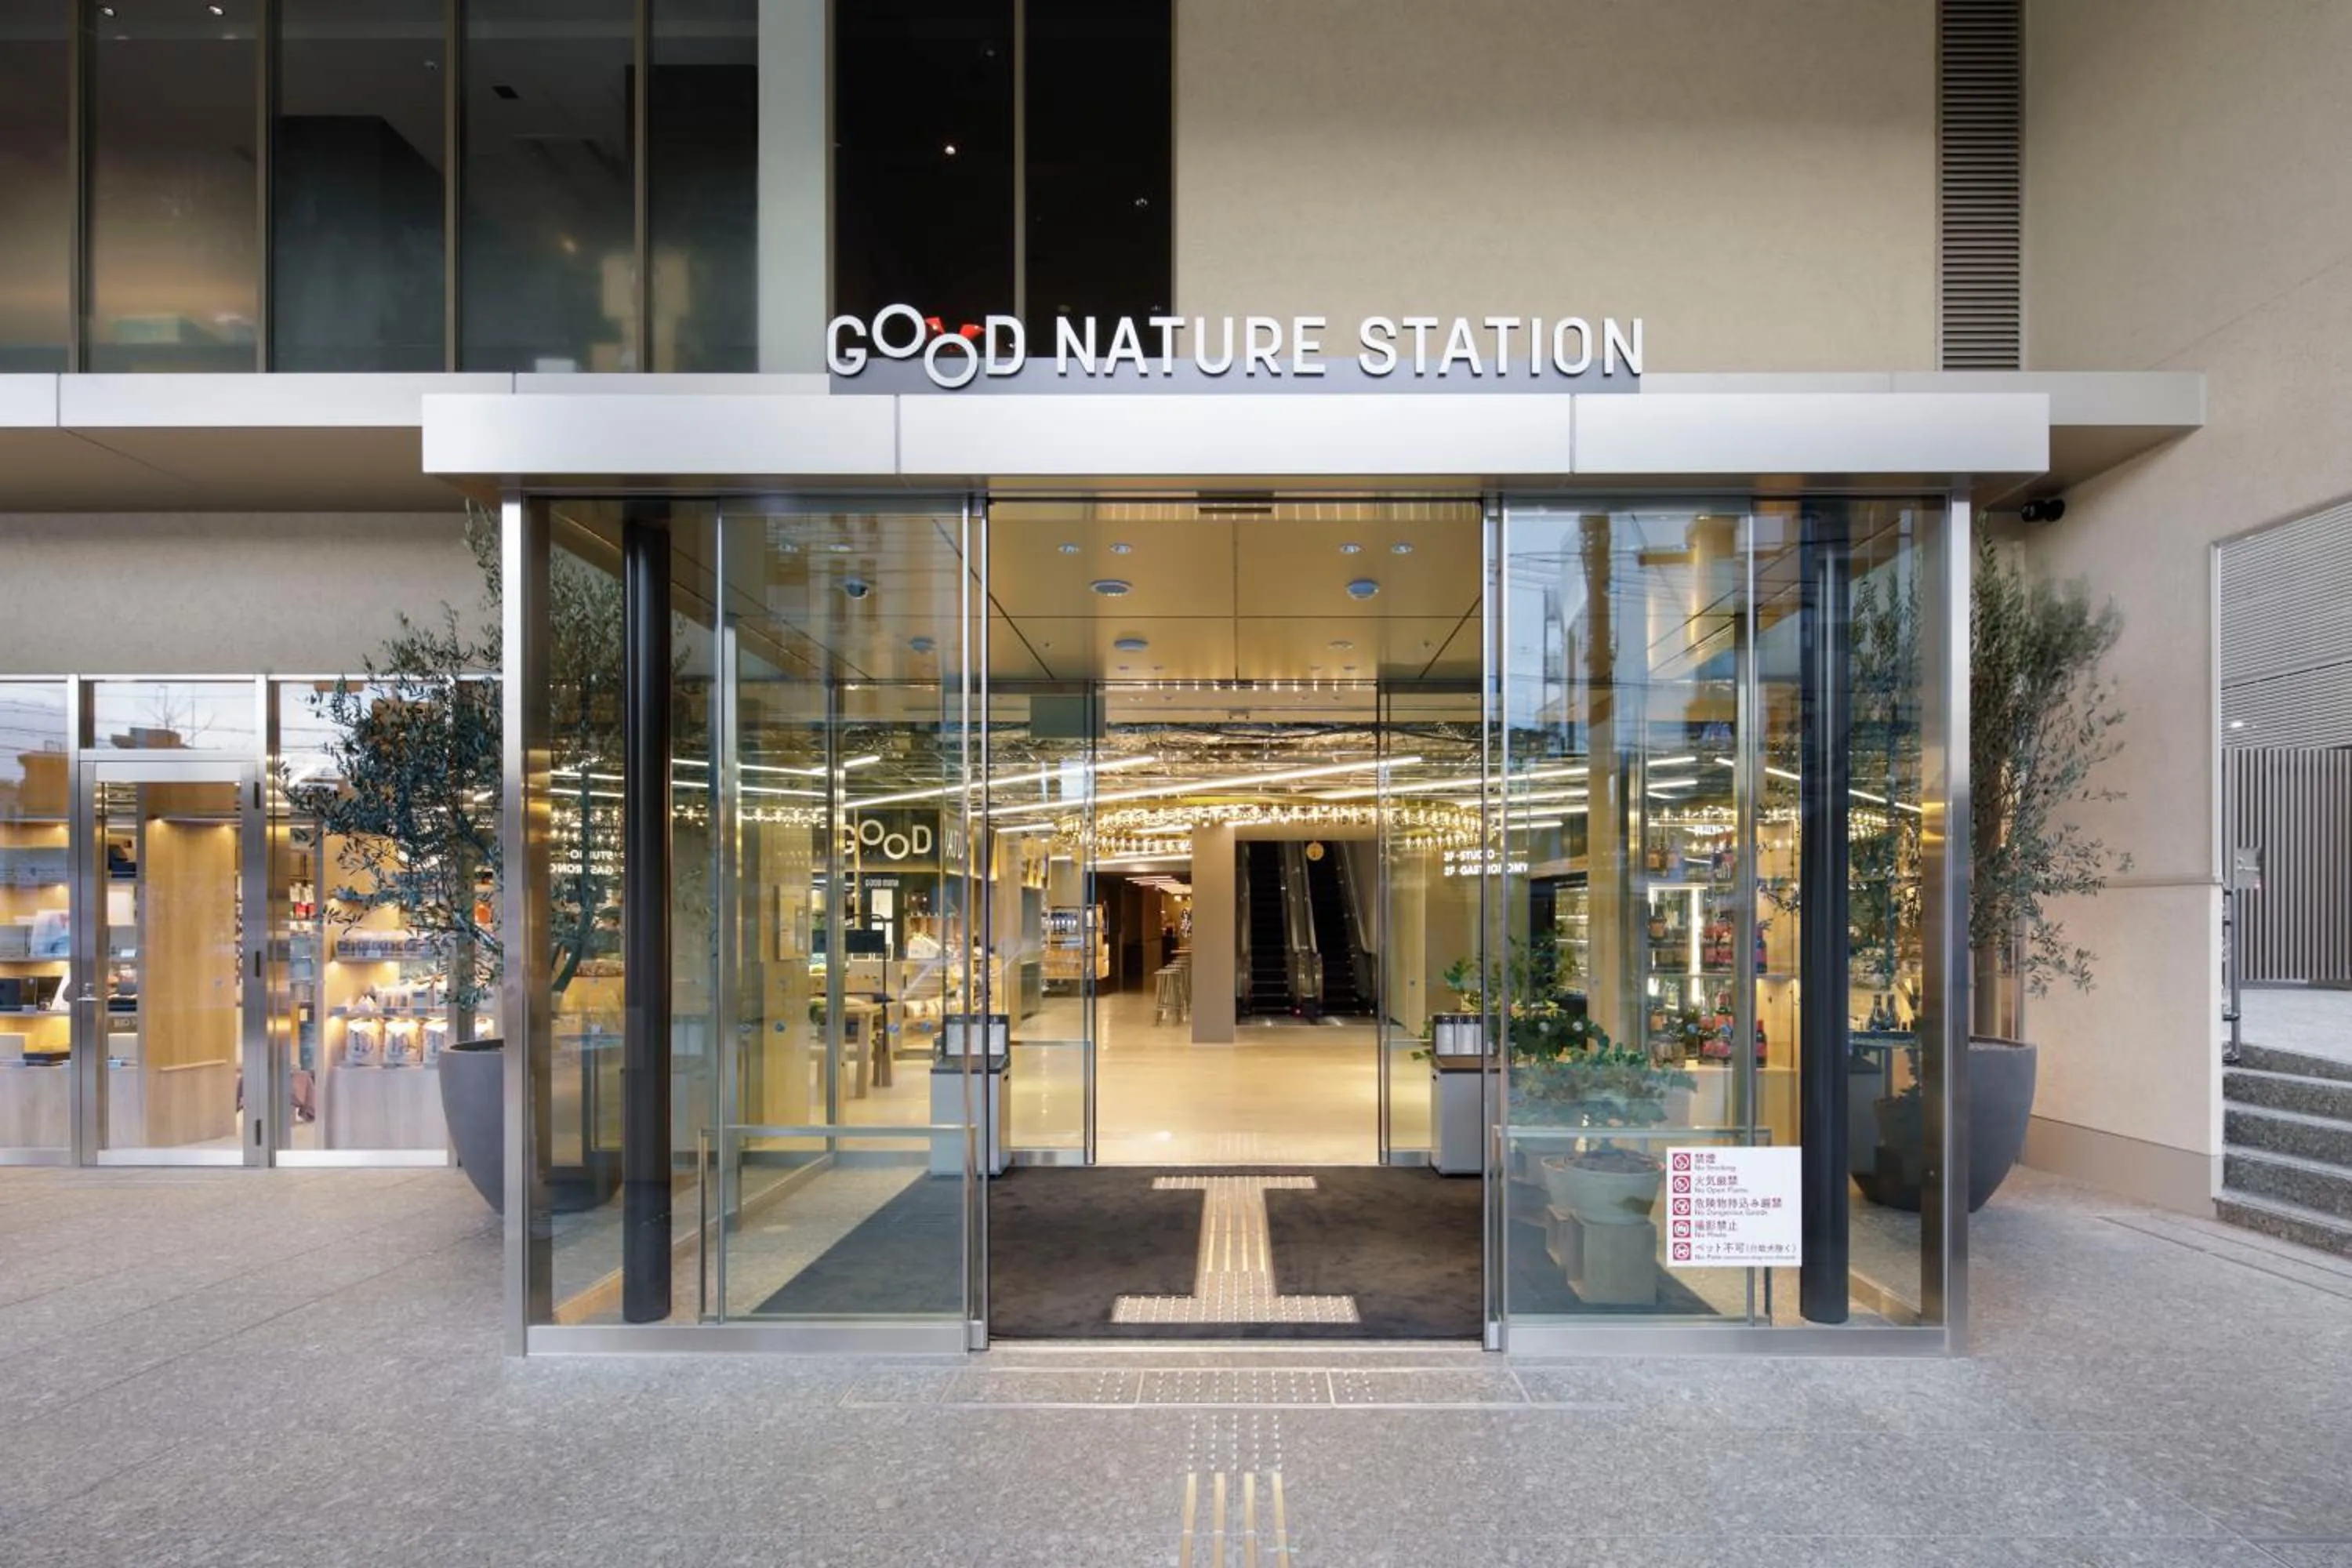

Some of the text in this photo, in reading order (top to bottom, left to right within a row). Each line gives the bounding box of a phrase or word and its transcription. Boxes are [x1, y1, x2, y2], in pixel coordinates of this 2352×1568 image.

[827, 303, 1642, 388] GOOD NATURE STATION
[1459, 849, 1495, 861] STUDO
